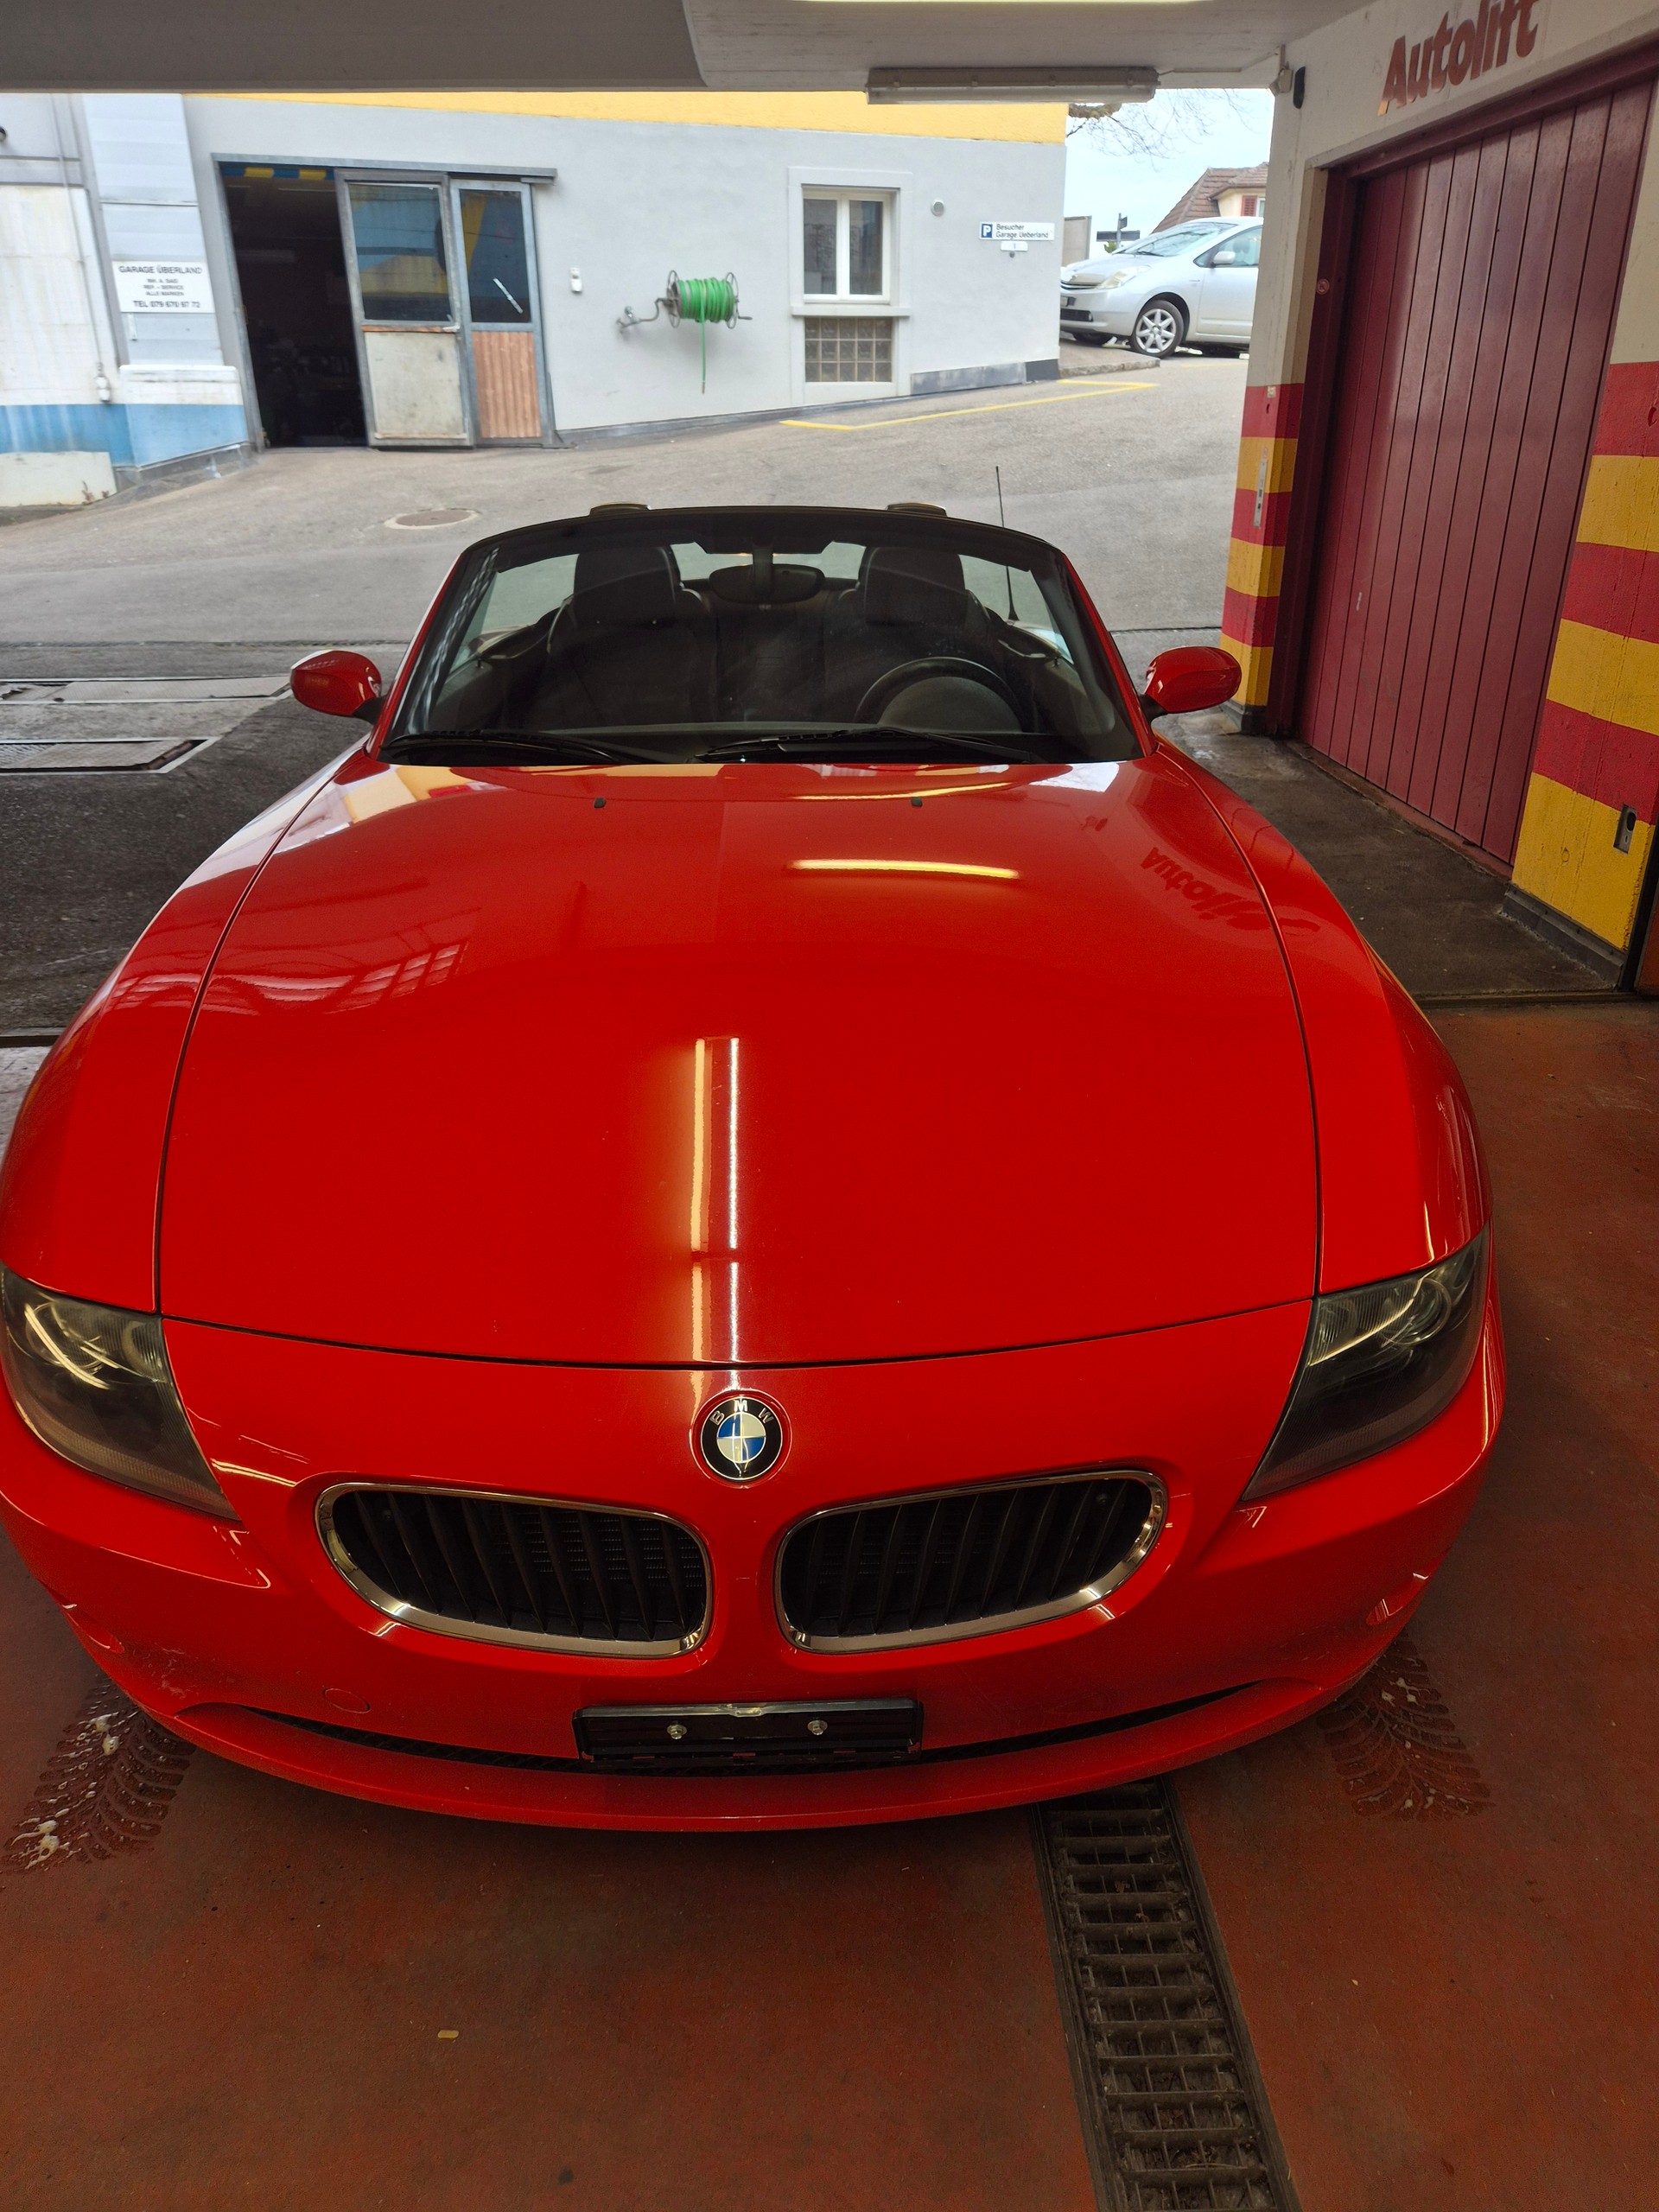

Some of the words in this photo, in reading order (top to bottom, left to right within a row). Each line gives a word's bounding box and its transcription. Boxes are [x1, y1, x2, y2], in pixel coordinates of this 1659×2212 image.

[1376, 0, 1539, 117] Autolift
[995, 231, 1018, 239] Garage
[156, 264, 203, 274] ÜBERLAND
[709, 1399, 775, 1426] BMW
